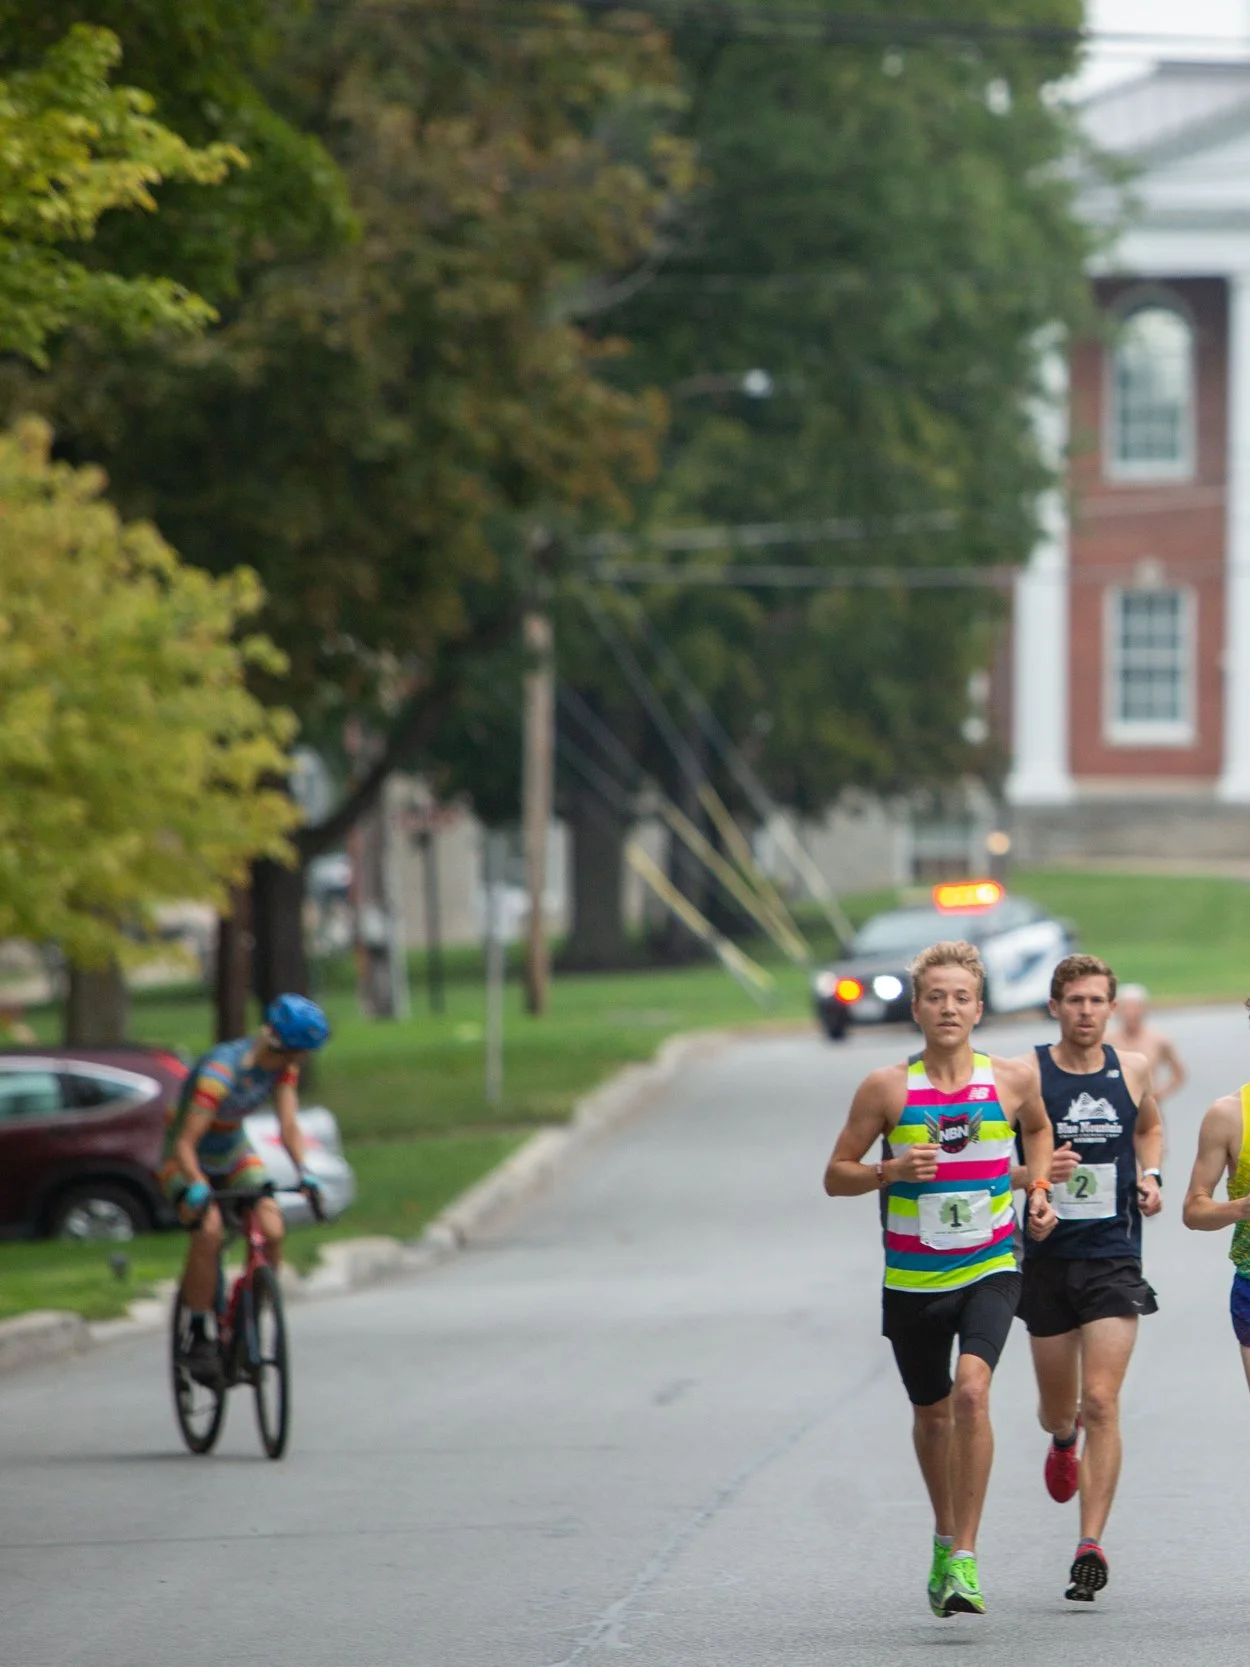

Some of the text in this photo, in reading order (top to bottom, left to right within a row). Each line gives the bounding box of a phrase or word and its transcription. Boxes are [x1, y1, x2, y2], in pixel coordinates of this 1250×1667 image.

[940, 1123, 969, 1142] NBN
[1075, 1175, 1089, 1198] 2
[949, 1203, 962, 1228] 1
